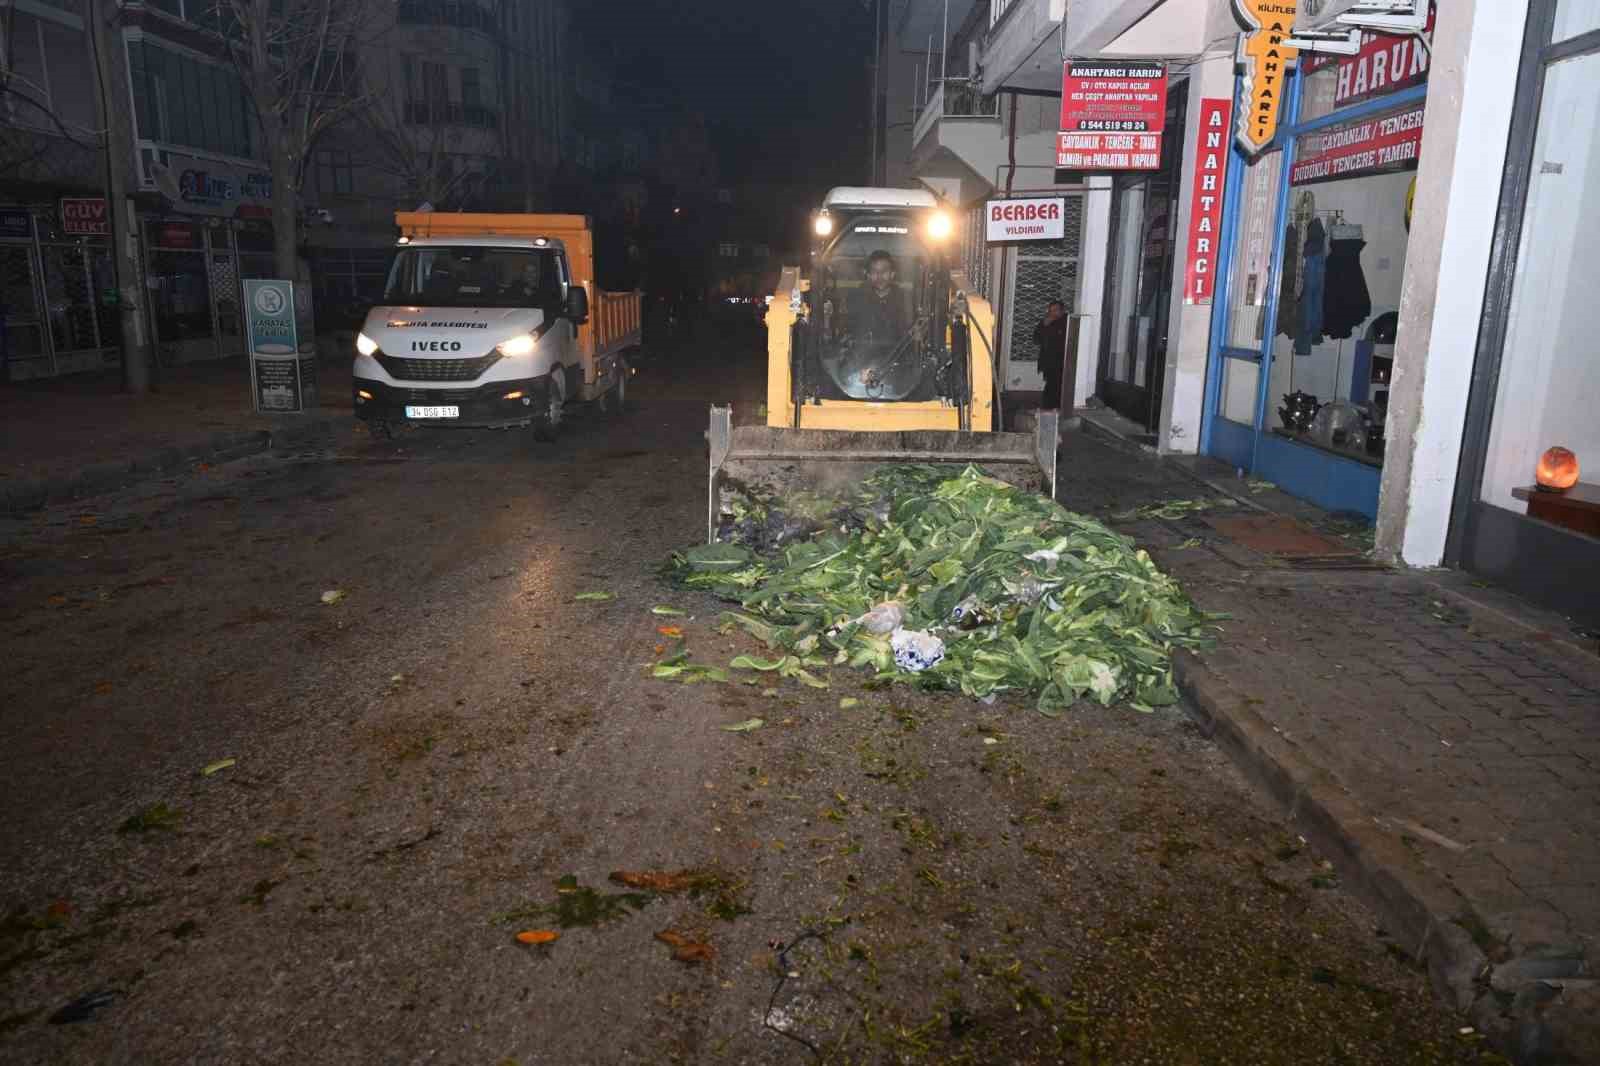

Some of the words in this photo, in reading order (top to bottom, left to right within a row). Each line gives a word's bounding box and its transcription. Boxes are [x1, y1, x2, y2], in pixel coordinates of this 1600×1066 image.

[1071, 68, 1126, 78] ANAHTARCI
[1128, 69, 1162, 78] HARUN
[1258, 22, 1282, 136] ANAHTARCI
[1336, 38, 1427, 102] HARUN
[1080, 121, 1086, 129] 0
[1088, 121, 1103, 129] 544
[1105, 135, 1134, 149] TENCERE
[1321, 125, 1371, 153] ÇAYDANLIK
[1332, 151, 1375, 174] TENCERE
[1195, 110, 1222, 294] ANAHTARCI
[992, 203, 1059, 221] BERBER
[1006, 225, 1045, 235] YILDIRIM
[412, 341, 461, 352] IVECO
